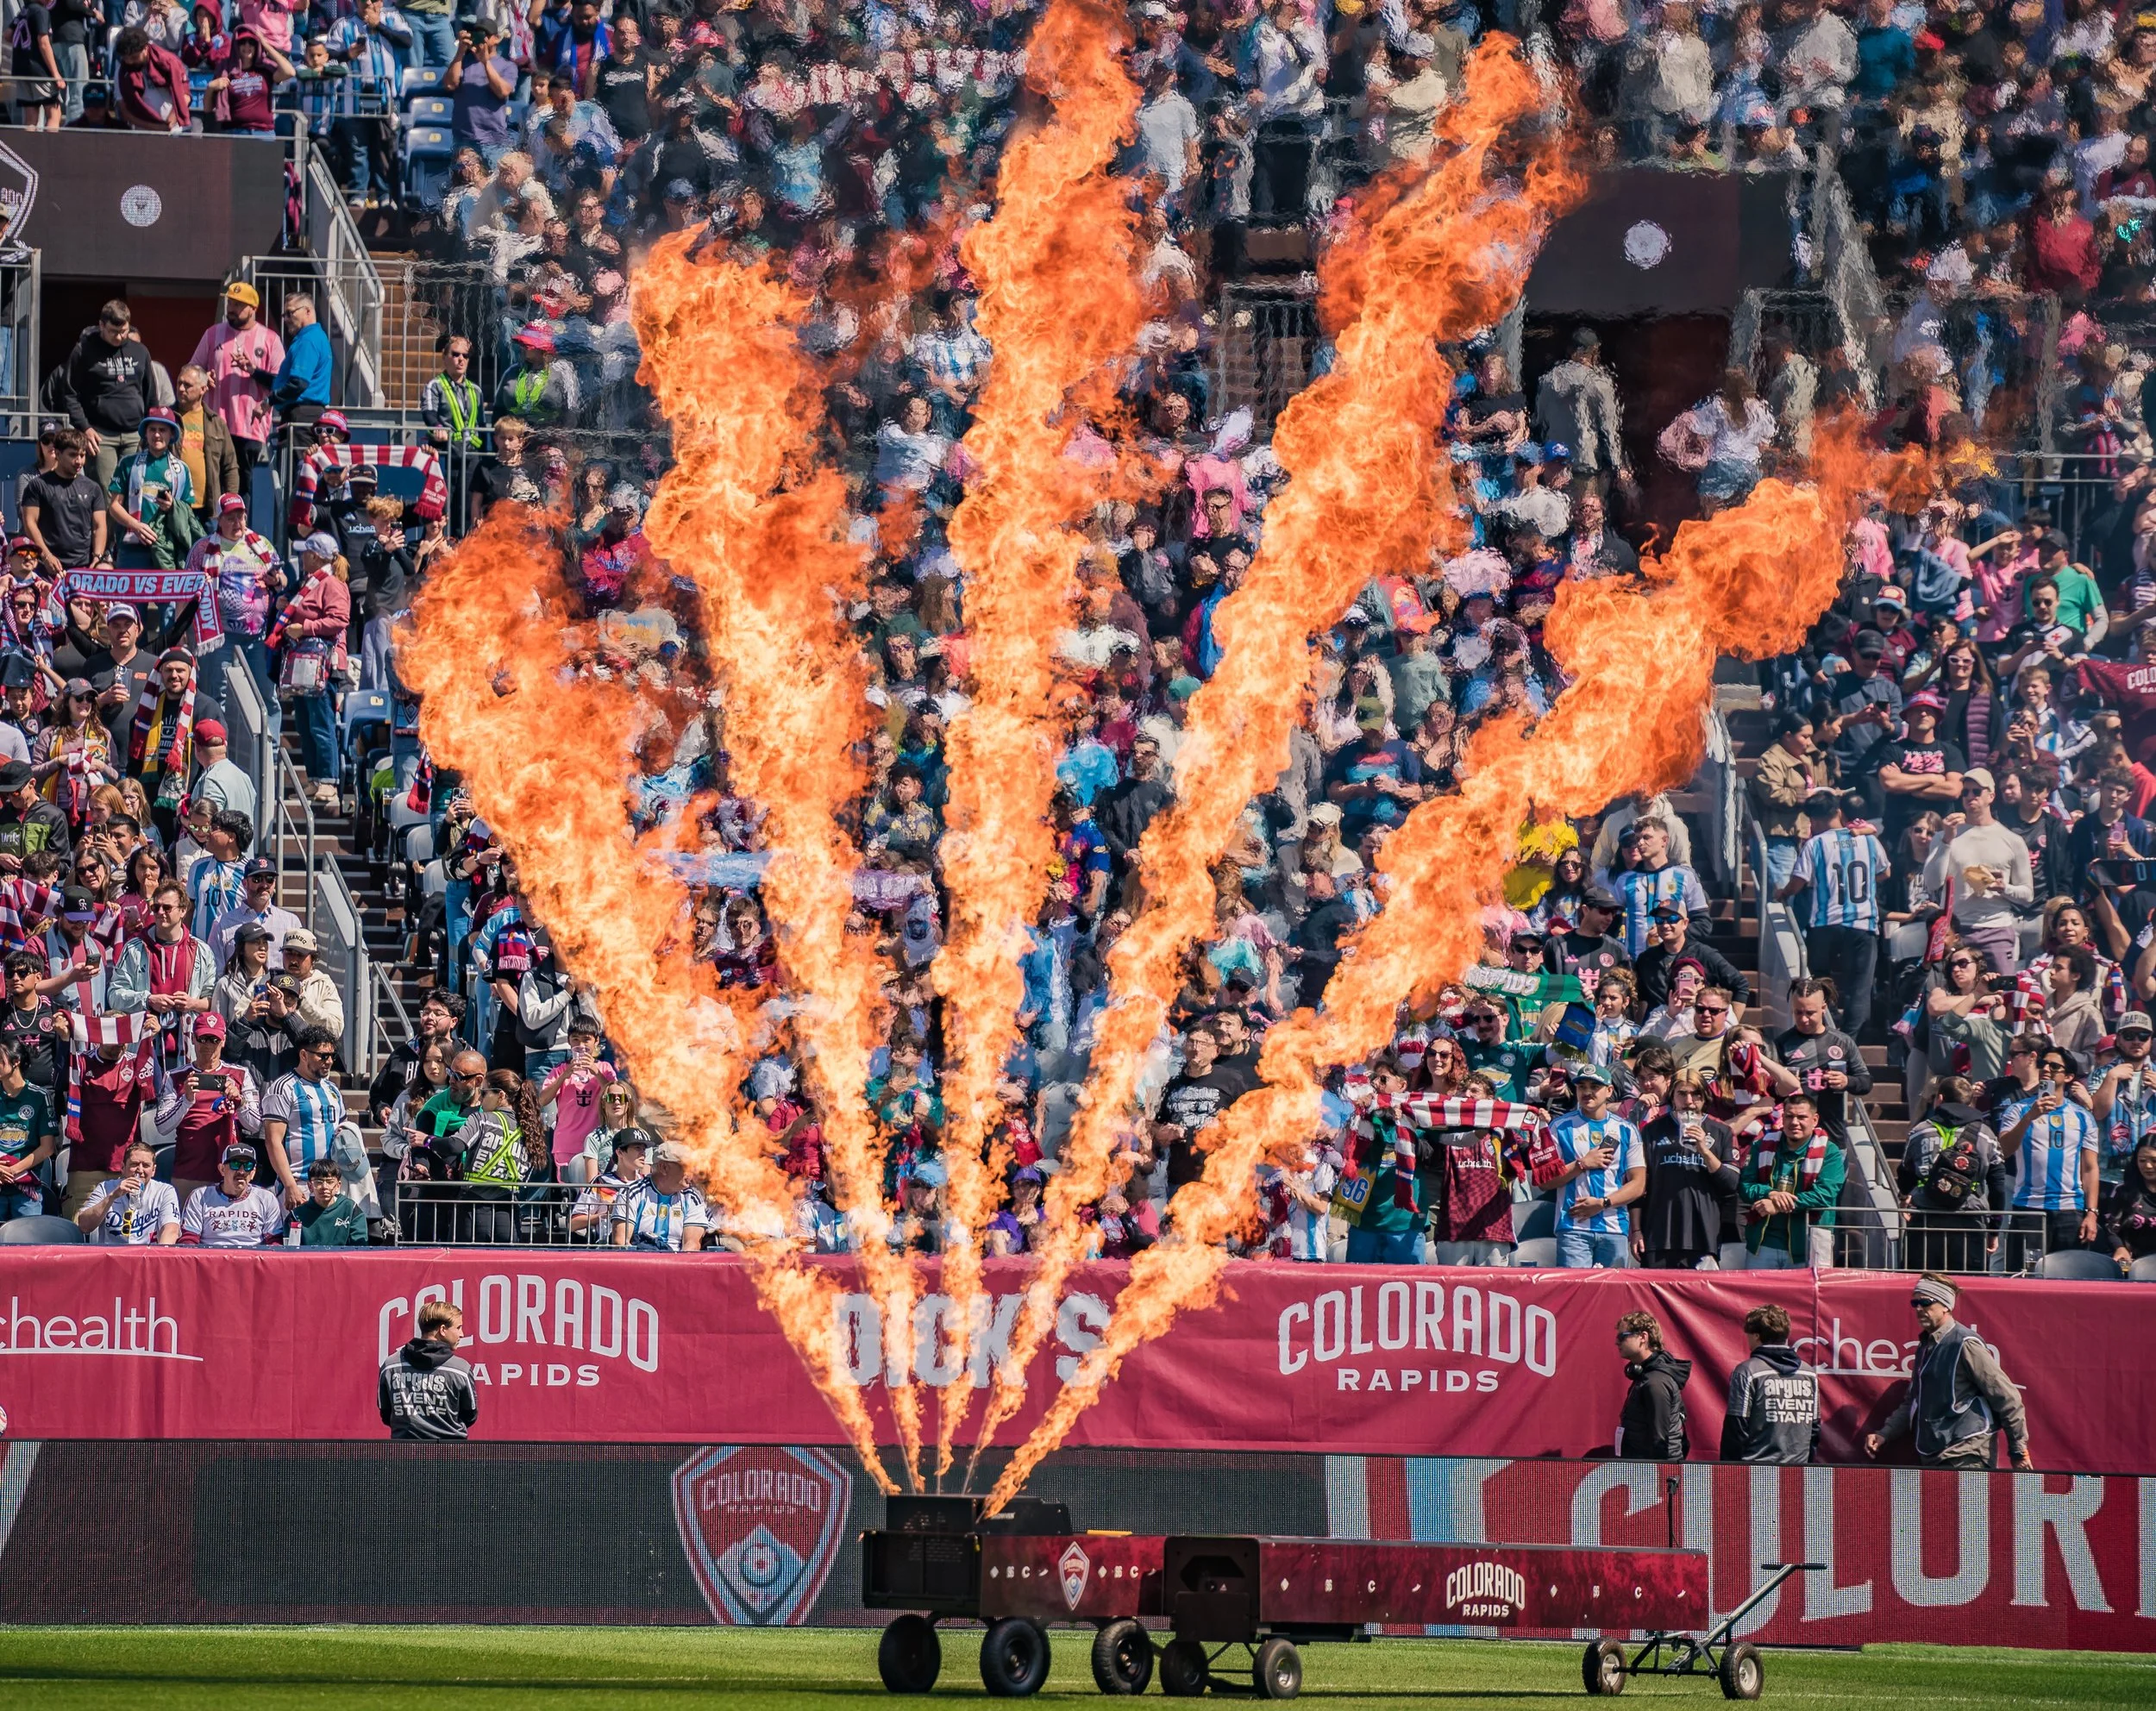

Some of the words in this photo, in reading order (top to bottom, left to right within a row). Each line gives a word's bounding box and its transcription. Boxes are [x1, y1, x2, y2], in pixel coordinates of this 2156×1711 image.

[348, 523, 376, 533] uchea
[135, 576, 157, 595] VS
[1832, 861, 1868, 905] 10
[205, 889, 222, 906] 10
[321, 1105, 335, 1123] 10
[480, 1131, 530, 1163] arus
[2048, 1130, 2064, 1148] 10
[105, 1206, 160, 1237] Ddgers
[209, 1210, 258, 1219] RAPIDS
[0, 1295, 178, 1354] health
[1278, 1282, 1557, 1377] COLORADO
[830, 1292, 1112, 1389] DICKS
[473, 1363, 600, 1387] APIDS
[1337, 1369, 1500, 1392] RAPIDS
[393, 1392, 447, 1406] EVENT
[1764, 1398, 1814, 1411] EVENT
[394, 1406, 447, 1418] STAFF
[1765, 1410, 1814, 1424] STAFF
[702, 1469, 822, 1512] COLORADO
[1571, 1463, 2156, 1640] COLOR
[1445, 1562, 1526, 1610] COLORADO
[1462, 1603, 1509, 1618] RAPIDS
